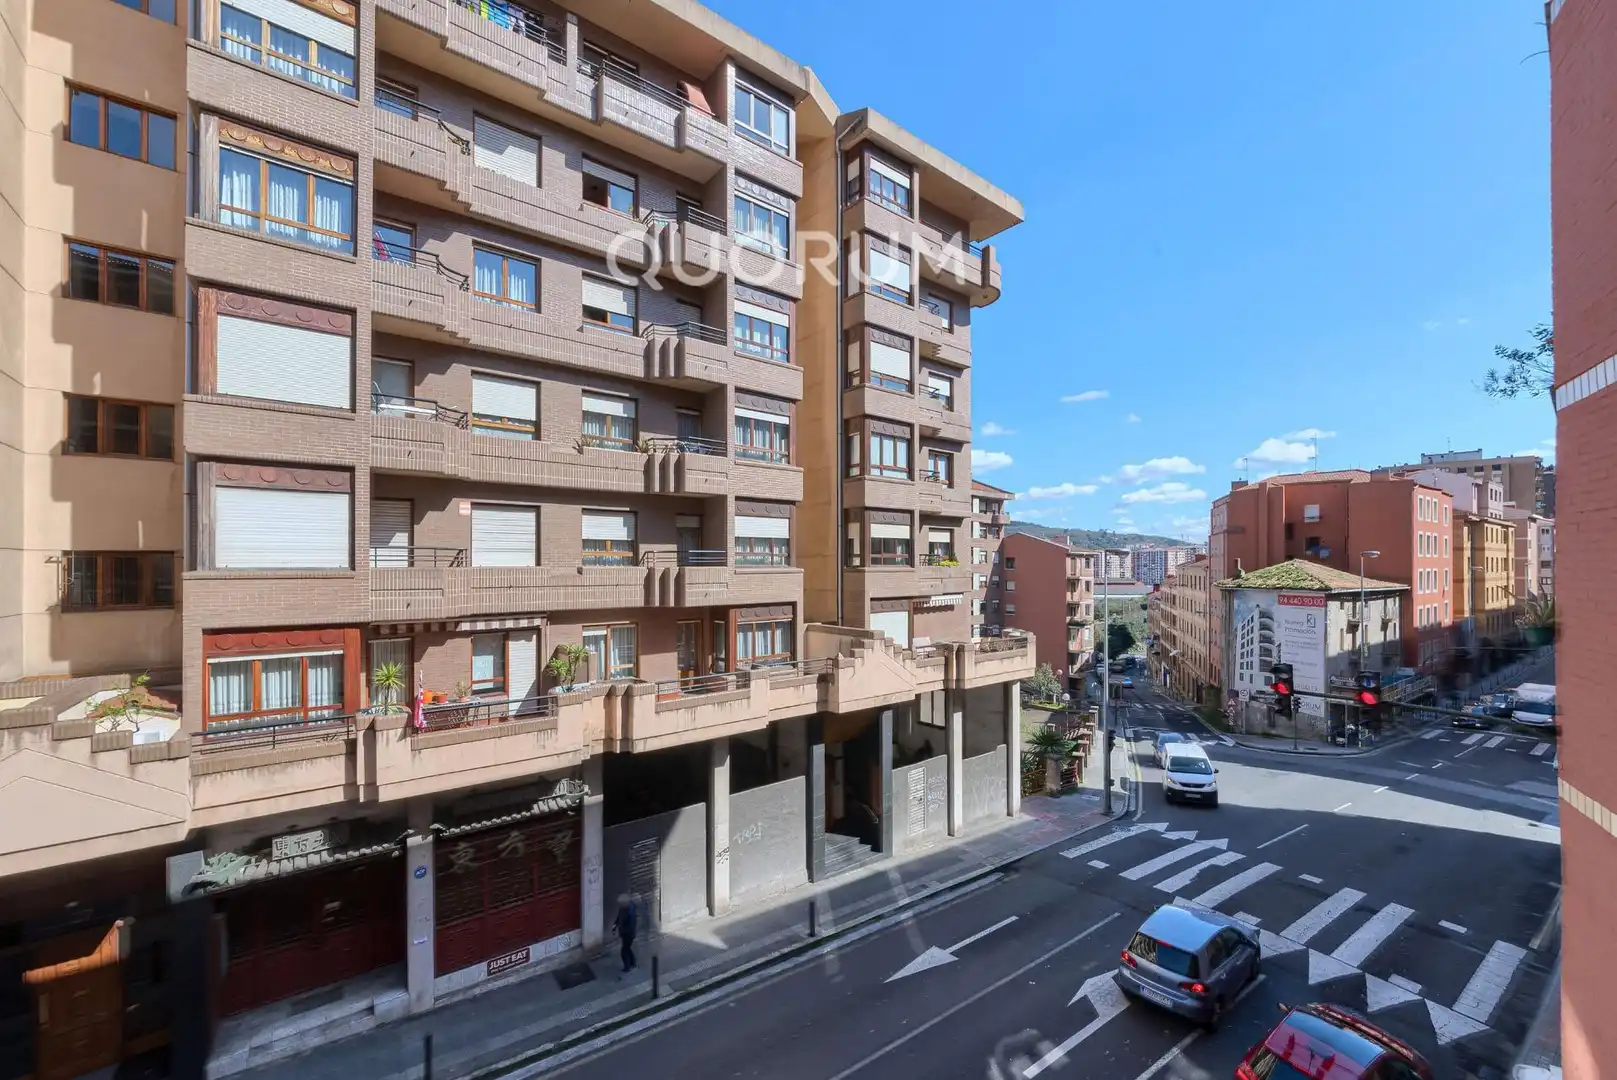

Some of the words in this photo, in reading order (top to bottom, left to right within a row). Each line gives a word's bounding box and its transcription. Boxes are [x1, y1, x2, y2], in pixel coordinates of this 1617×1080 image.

[1279, 596, 1288, 604] 94
[1289, 597, 1302, 605] 440
[489, 956, 510, 970] JUST
[511, 949, 529, 962] EAT
